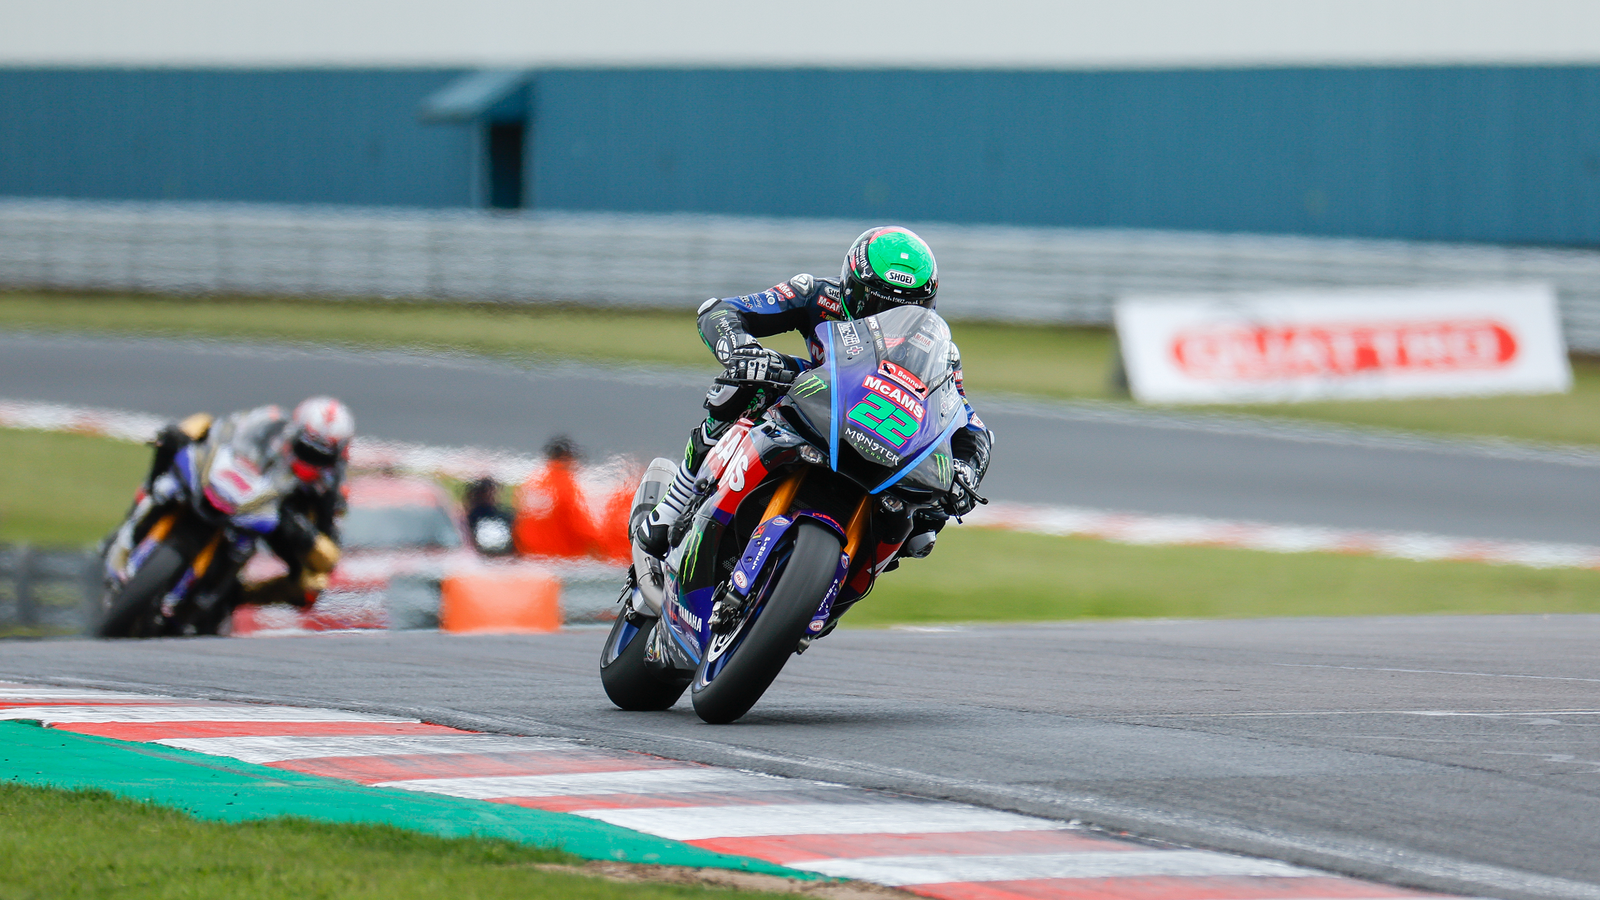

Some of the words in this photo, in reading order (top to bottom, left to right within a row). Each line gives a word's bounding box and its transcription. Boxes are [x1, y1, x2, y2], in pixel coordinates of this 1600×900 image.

[889, 272, 912, 284] SHOEI
[864, 376, 924, 419] McAMS
[847, 391, 921, 449] 22
[845, 427, 900, 466] MONSTER
[751, 536, 771, 570] PIRELLI
[818, 579, 838, 612] PIRELLI
